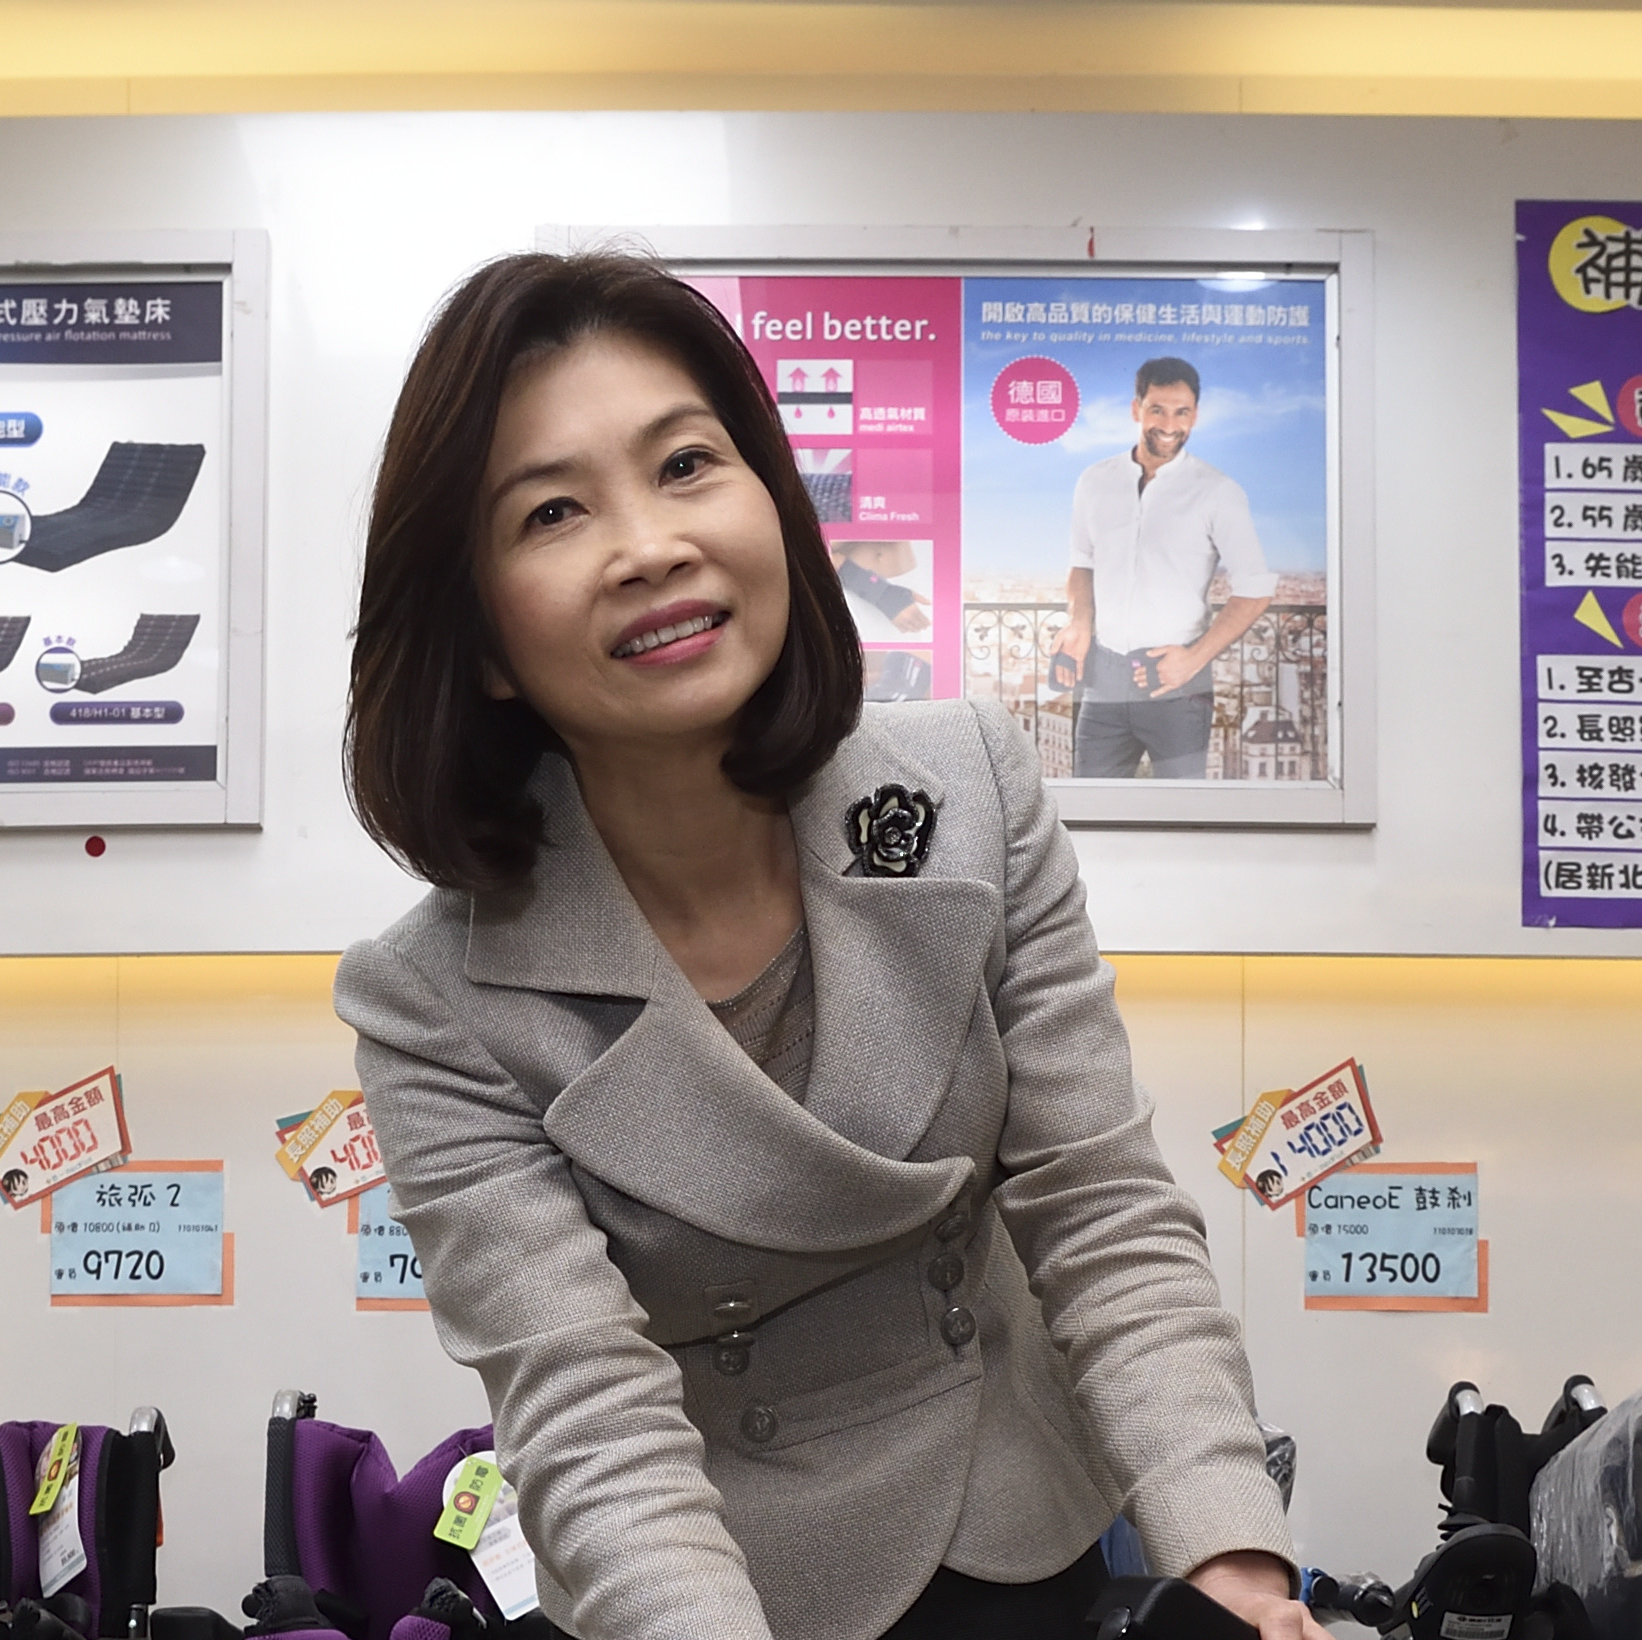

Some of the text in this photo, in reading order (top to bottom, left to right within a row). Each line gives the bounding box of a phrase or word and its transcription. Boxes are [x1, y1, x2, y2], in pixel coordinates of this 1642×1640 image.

[45, 329, 61, 342] air
[119, 328, 172, 341] mattress
[751, 311, 813, 341] feel
[823, 311, 937, 341] better.
[981, 330, 1002, 341] the
[1006, 330, 1030, 344] key
[1033, 331, 1045, 341] to
[1049, 330, 1094, 344] quality
[1098, 331, 1111, 342] in
[1182, 331, 1234, 345] lifestyle
[1238, 332, 1263, 344] and
[1008, 379, 1063, 405] 德國
[34, 1086, 104, 1132] 最高金額
[1280, 1078, 1349, 1130] 最高金額
[20, 1118, 98, 1171] 4000
[83, 1250, 164, 1281] 9720
[1341, 1252, 1440, 1283] 13500
